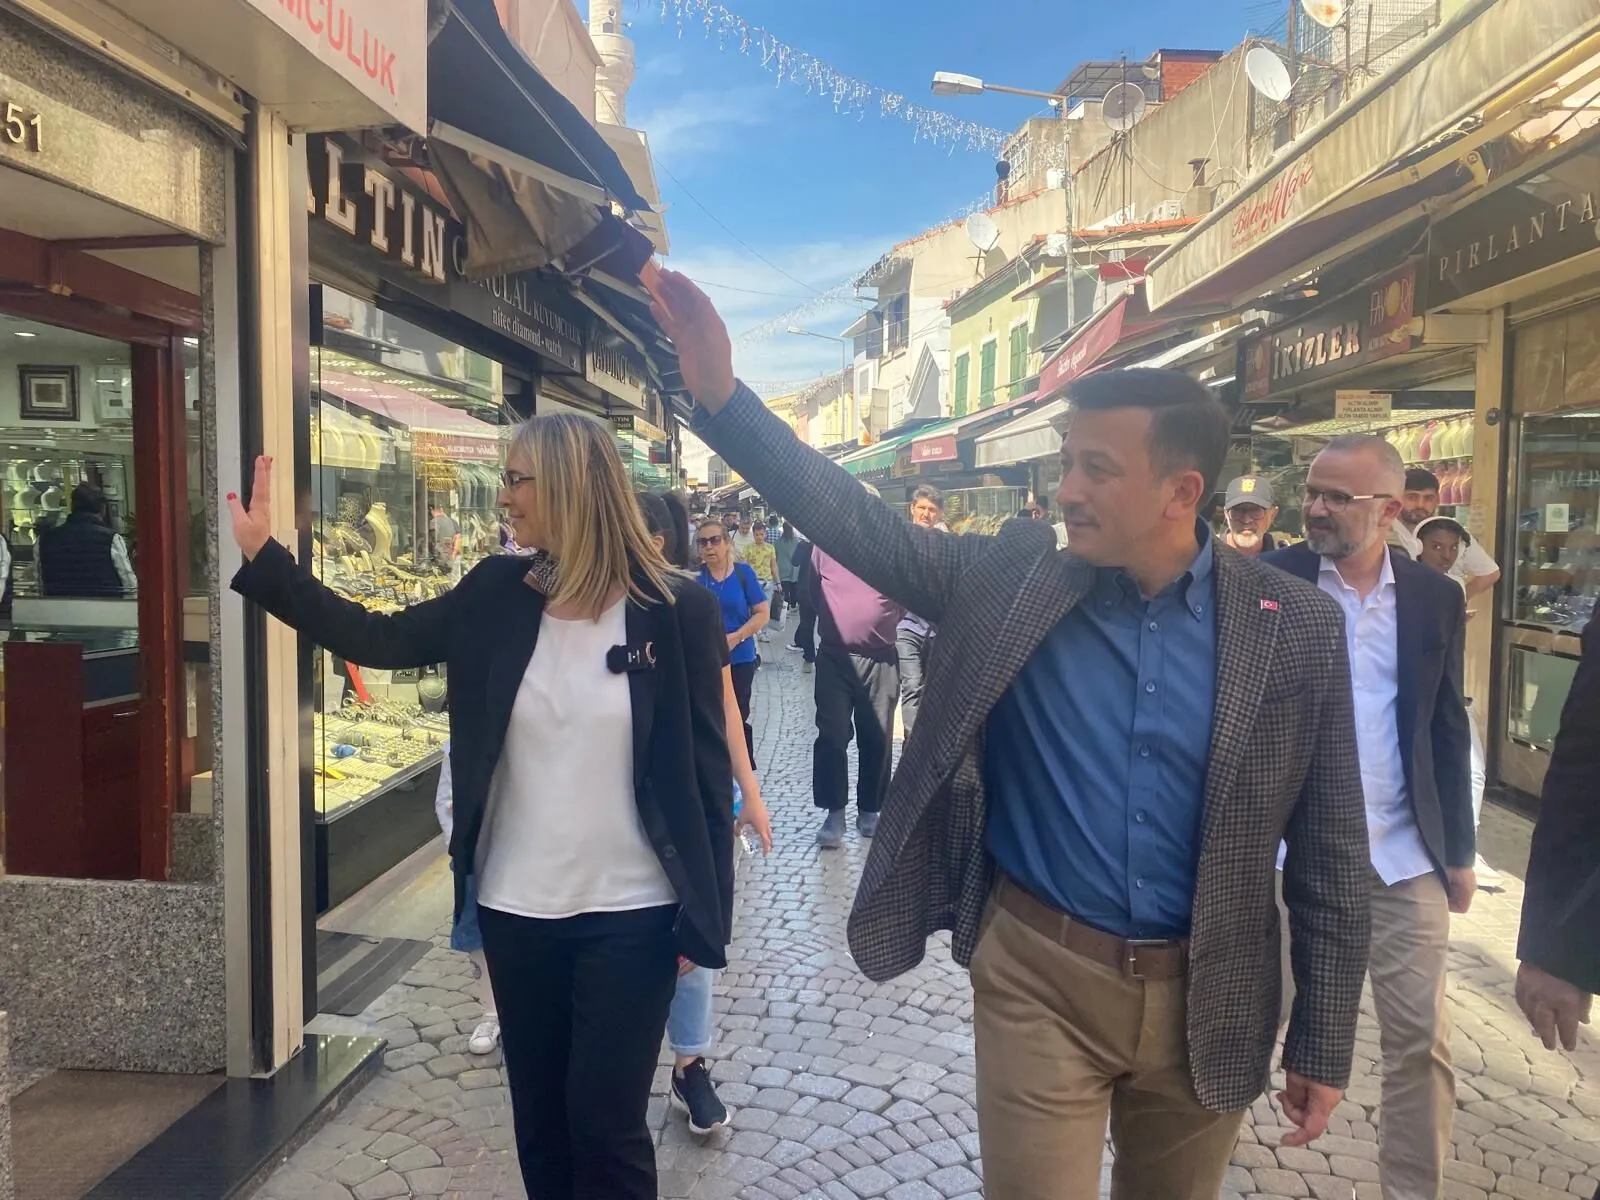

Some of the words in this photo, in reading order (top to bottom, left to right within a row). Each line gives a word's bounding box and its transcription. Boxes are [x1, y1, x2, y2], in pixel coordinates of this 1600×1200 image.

[278, 0, 396, 96] CULUK
[6, 102, 42, 152] 51
[307, 136, 446, 283] LTIN
[1439, 191, 1597, 281] PIRLANTA
[512, 315, 541, 347] diamond
[1273, 320, 1361, 380] İKİZLER
